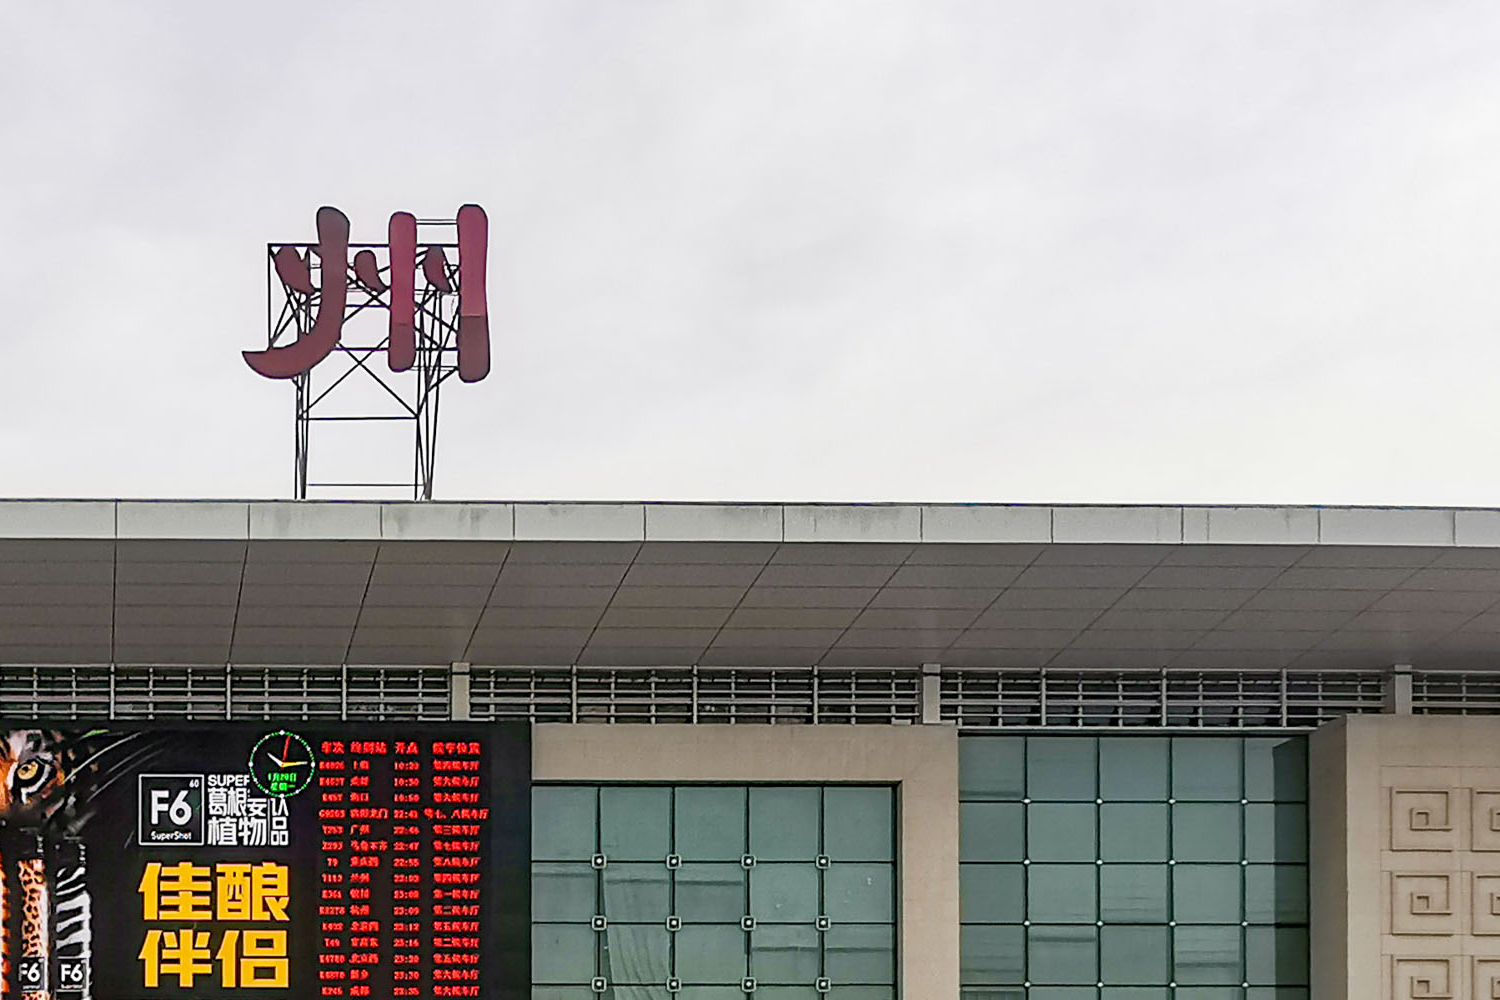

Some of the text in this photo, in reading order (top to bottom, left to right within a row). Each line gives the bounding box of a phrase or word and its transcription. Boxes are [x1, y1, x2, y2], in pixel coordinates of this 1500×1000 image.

[322, 741, 345, 755] 车次
[395, 742, 419, 755] 开点
[150, 789, 192, 826] F6
[138, 861, 290, 921] 佳酿
[61, 964, 83, 982] F6
[138, 929, 290, 988] 伴侣
